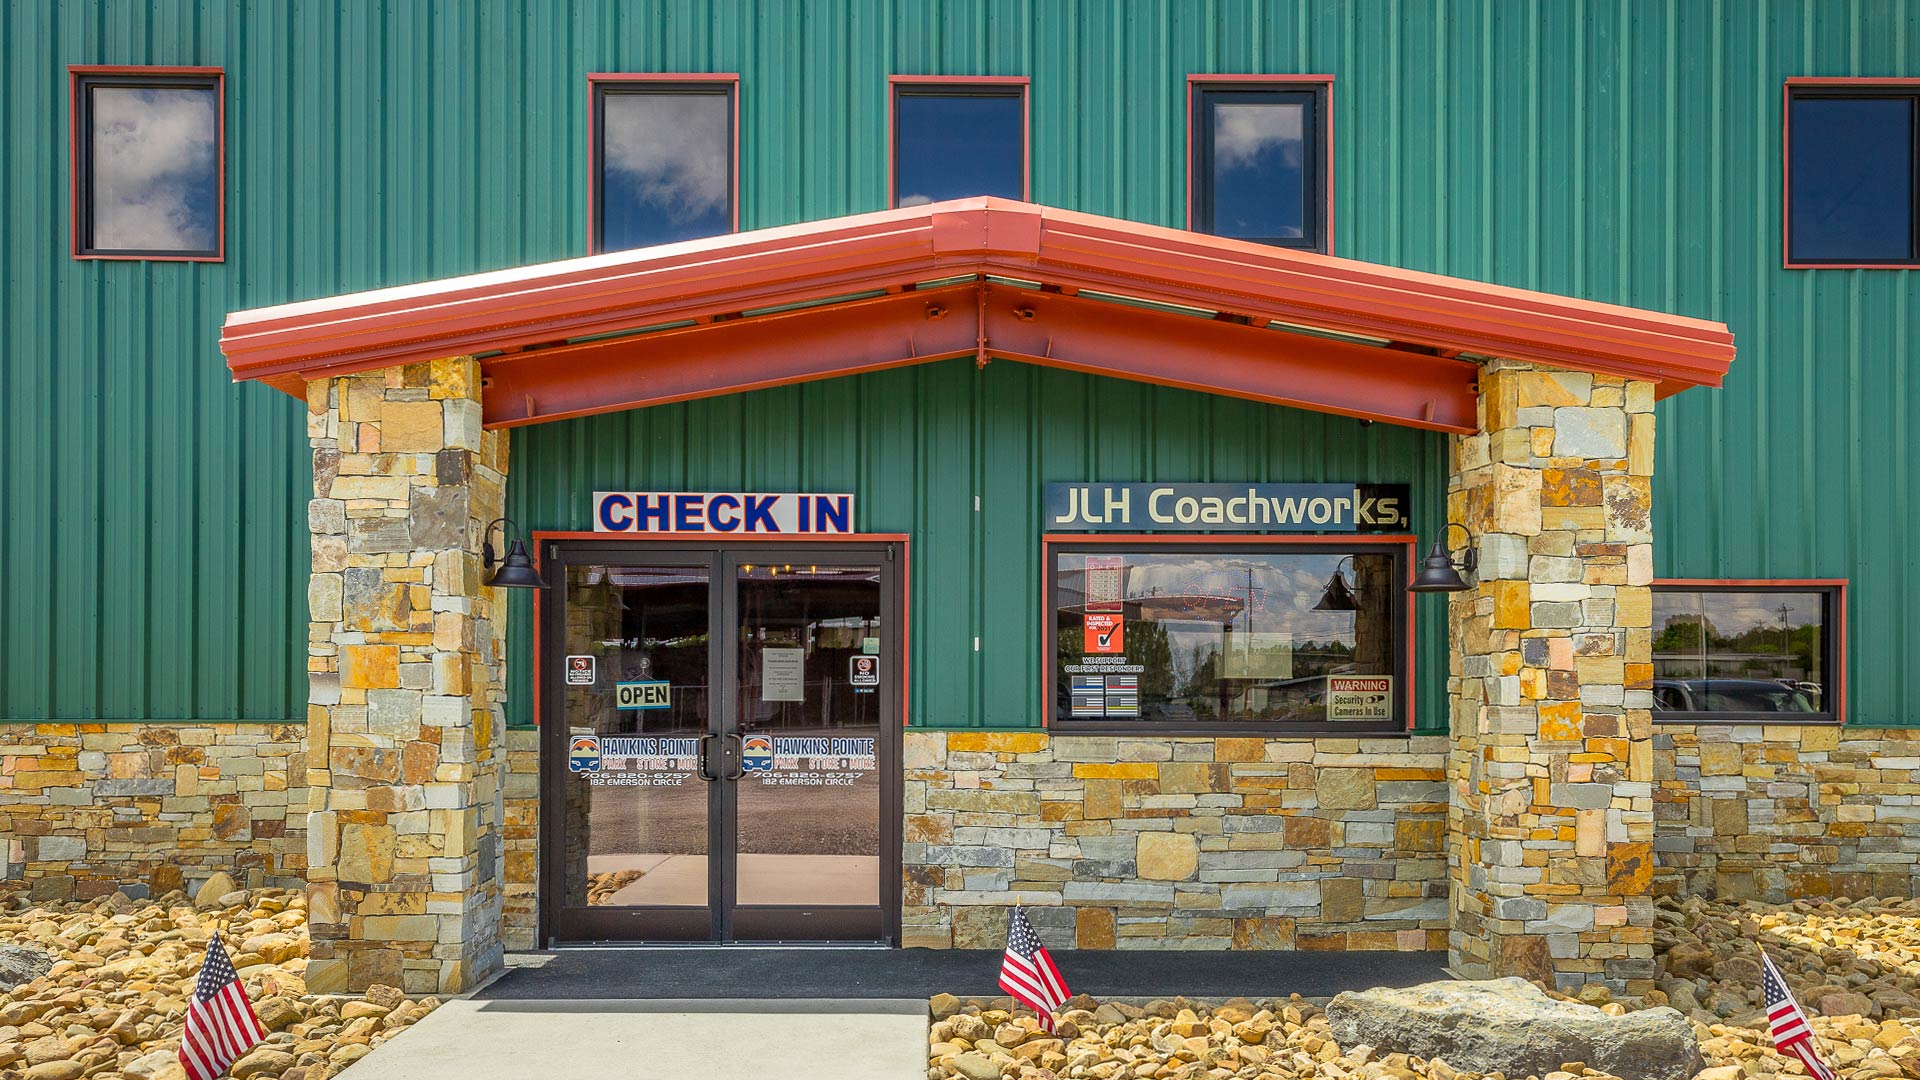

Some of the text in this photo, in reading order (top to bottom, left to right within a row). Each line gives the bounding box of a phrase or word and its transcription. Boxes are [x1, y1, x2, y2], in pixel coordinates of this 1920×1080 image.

[1055, 487, 1408, 527] JLH Coachworks,
[599, 494, 850, 533] CHECK IN
[1095, 657, 1126, 665] SUPPORT
[1334, 680, 1387, 690] WARNING
[620, 686, 667, 704] OPEN
[1334, 695, 1364, 706] Security
[1334, 707, 1386, 716] Cameras In Use
[601, 738, 657, 756] HAWKINS
[774, 738, 875, 756] HAWKINS POINTE
[601, 758, 703, 770] PARK STORE MOR
[774, 757, 876, 770] PARK STORE MORE
[780, 778, 822, 786] EMERSON
[825, 778, 854, 786] CIRCLE
